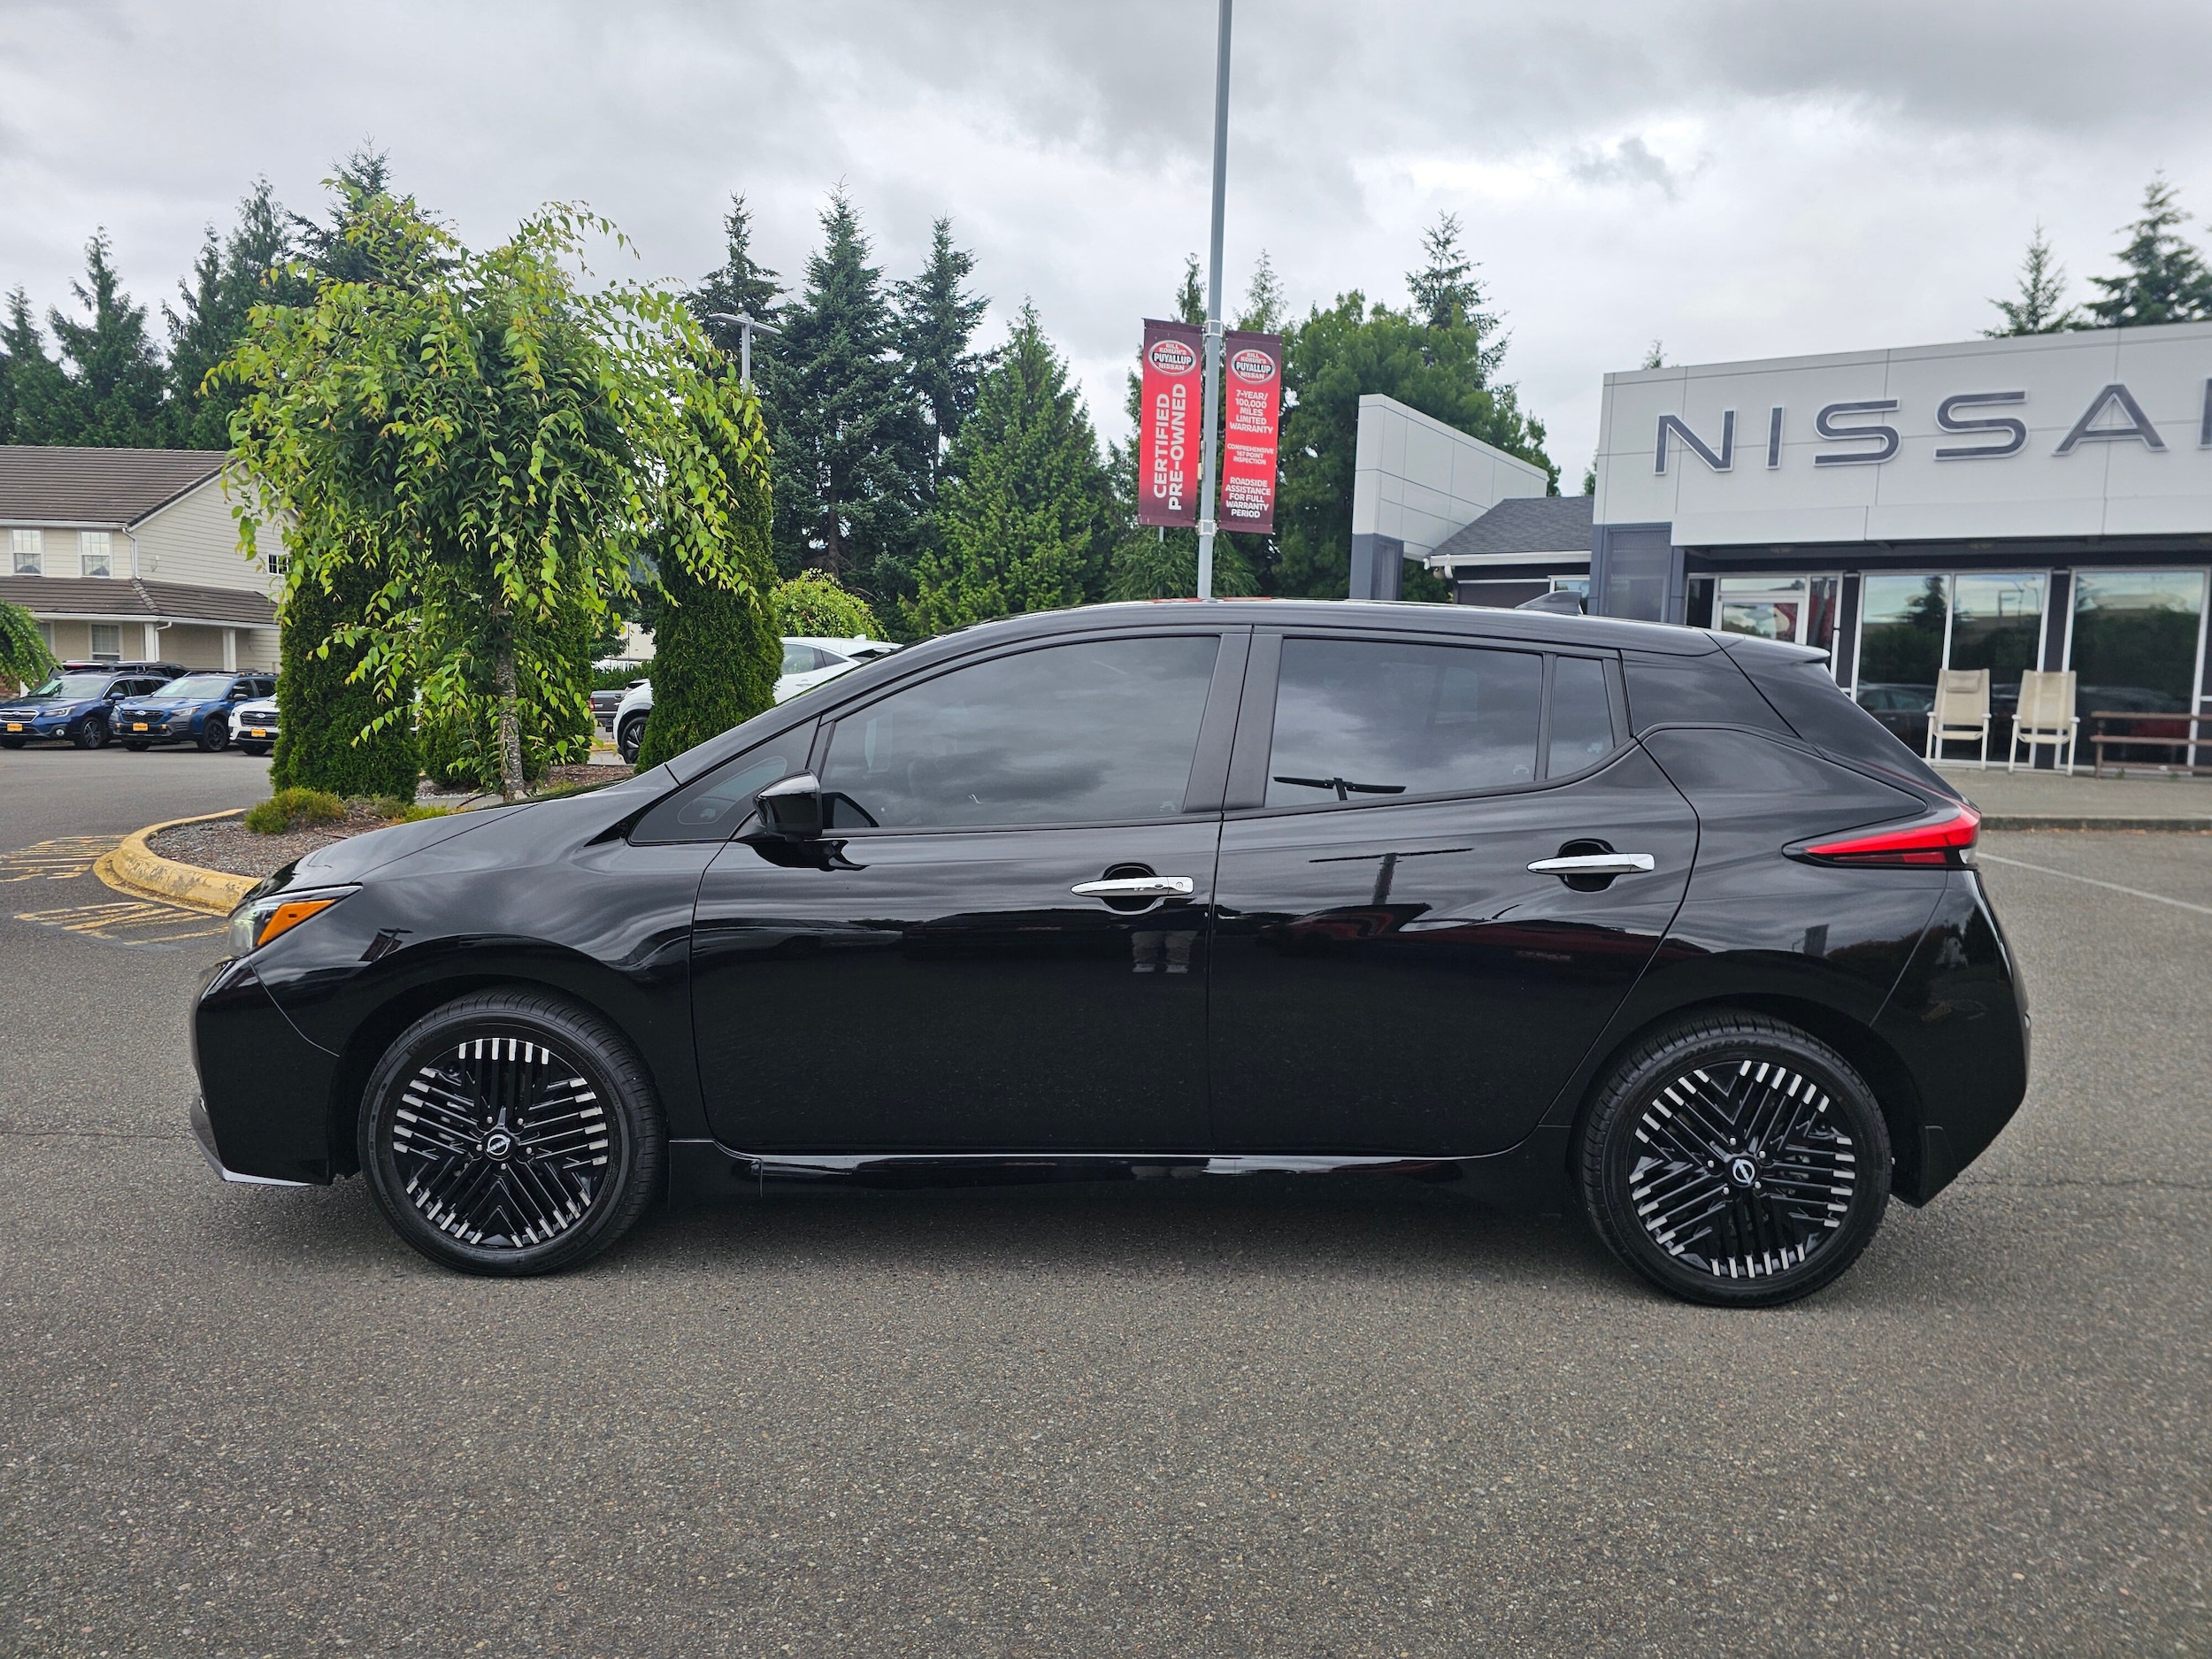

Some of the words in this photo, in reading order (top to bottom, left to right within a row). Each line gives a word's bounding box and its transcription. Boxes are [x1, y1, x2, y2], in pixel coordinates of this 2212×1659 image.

[1154, 352, 1191, 365] PUYALLUP
[1236, 361, 1271, 373] PUYALLUP
[1240, 371, 1265, 379] NISSAN
[1236, 389, 1268, 400] 7-YEAR/
[1235, 398, 1267, 408] 100,000
[1240, 407, 1263, 416] MILES
[1236, 414, 1267, 425] LIMITED
[1229, 422, 1274, 434] WARRANTY
[1653, 376, 2212, 475] NISSA
[1154, 394, 1170, 498] CERTIFIED
[1168, 384, 1187, 511] PRE-OWNED
[1227, 443, 1275, 454] COMPREHENSIVE
[1233, 456, 1267, 465] INSPECTION
[1230, 477, 1267, 488] ROADSIDE
[1225, 484, 1271, 495] ASSISTANCE
[1229, 493, 1245, 502] FOR
[1246, 494, 1265, 503] FULL
[1225, 500, 1269, 511] WARRANTY
[1231, 509, 1260, 518] PERIOD
